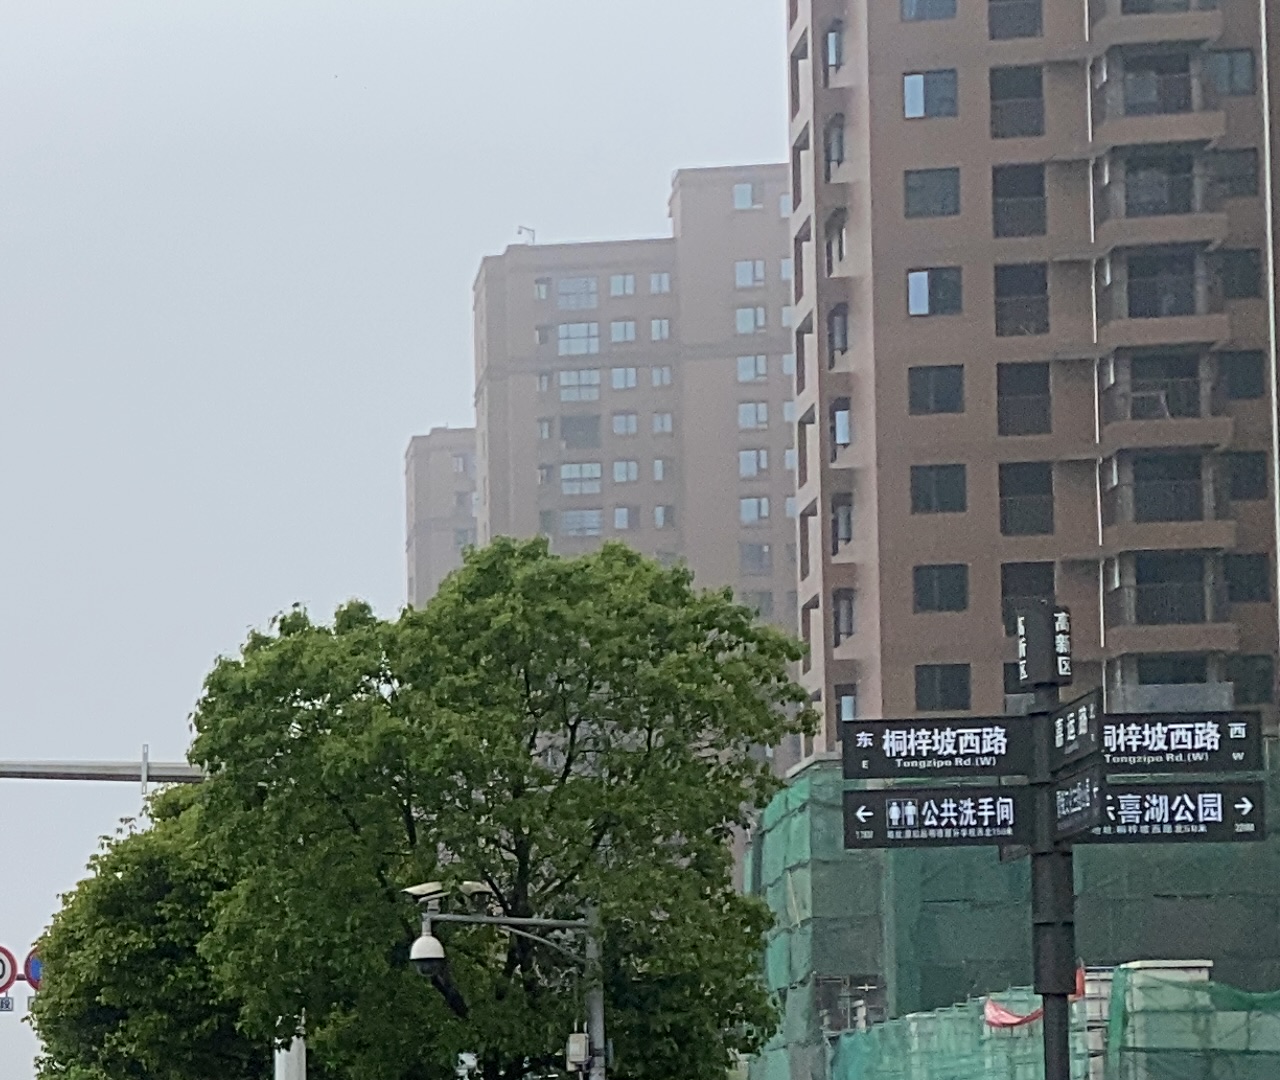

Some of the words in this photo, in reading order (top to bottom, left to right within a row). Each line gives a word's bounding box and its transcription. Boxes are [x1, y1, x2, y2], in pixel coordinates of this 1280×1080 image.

[1228, 723, 1247, 739] 西
[856, 731, 874, 748] 东
[882, 726, 1008, 757] 桐梓坡西路
[861, 760, 869, 769] E
[1232, 752, 1245, 761] W
[921, 796, 1014, 827] 公共洗手间
